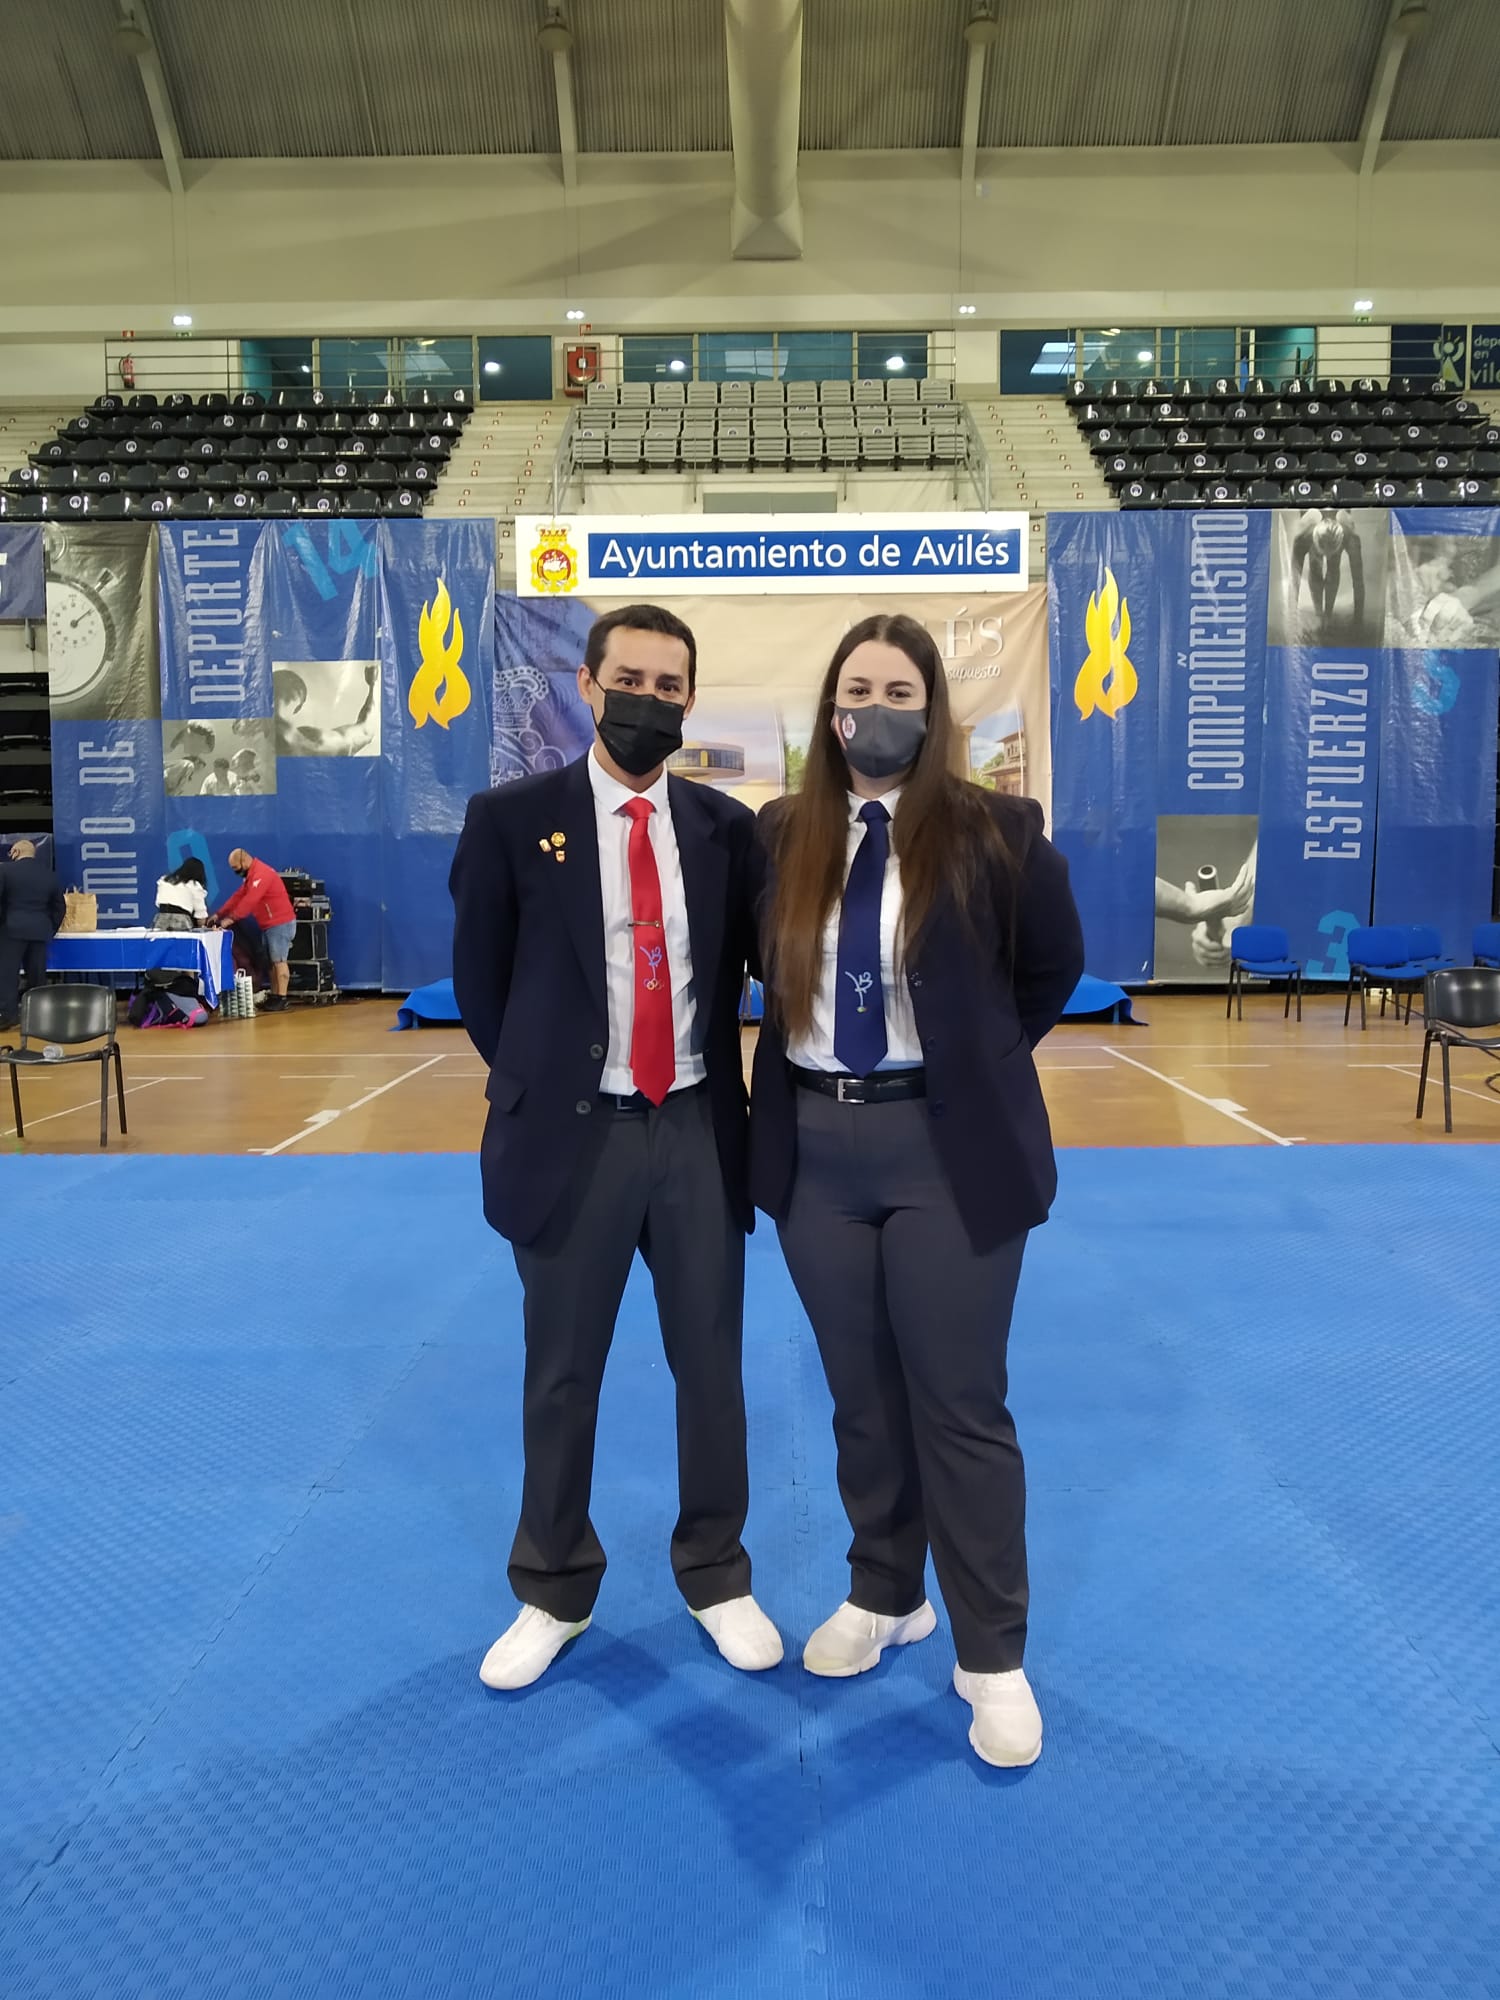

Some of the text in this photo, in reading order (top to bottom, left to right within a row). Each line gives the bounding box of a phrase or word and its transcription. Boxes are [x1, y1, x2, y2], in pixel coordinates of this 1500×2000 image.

[1473, 350, 1489, 359] en
[600, 533, 1010, 578] Ayuntamiento de Avilés
[182, 528, 246, 705] DEPORTE
[1177, 513, 1249, 790] COMPAÑERISMO
[78, 741, 135, 786] DE
[1303, 662, 1369, 860] ESFUERZO
